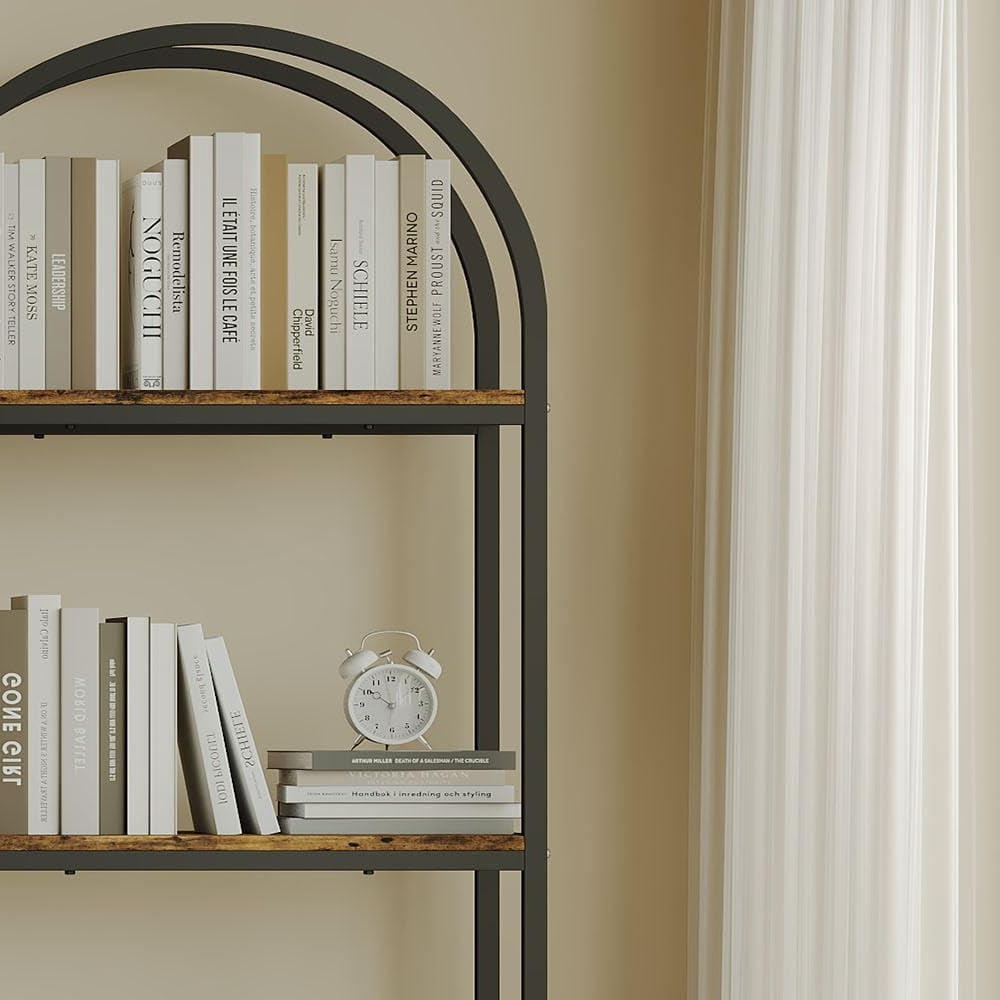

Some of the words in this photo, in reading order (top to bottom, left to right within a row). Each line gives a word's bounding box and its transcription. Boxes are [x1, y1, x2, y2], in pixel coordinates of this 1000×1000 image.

[222, 198, 238, 208] IL
[431, 179, 444, 218] SQUID
[7, 225, 16, 240] TIM
[222, 211, 241, 242] ÉTAIT
[406, 211, 418, 266] MARINO
[7, 243, 16, 281] WALKER
[26, 245, 38, 281] KATE
[172, 231, 186, 314] Remodelista
[222, 245, 238, 268] UNE
[330, 238, 343, 275] Isamu
[431, 246, 444, 296] PROUST
[51, 253, 66, 311] LEADERSHIP
[142, 217, 162, 338] NOGUCHI
[222, 271, 238, 296] FOIS
[353, 259, 369, 331] SCHIELE
[7, 283, 16, 313] STORY
[26, 284, 38, 321] MOSS
[222, 298, 238, 312] LE
[327, 279, 343, 334] Noguchi
[406, 270, 418, 332] STEPHEN
[433, 302, 442, 326] WOLF
[7, 315, 16, 346] TELLER
[222, 314, 241, 343] CAFÉ
[291, 308, 304, 370] Chipperfield
[304, 308, 315, 337] David
[433, 328, 442, 376] MARYANNE
[398, 791, 442, 799] inredning
[463, 791, 492, 799] styling
